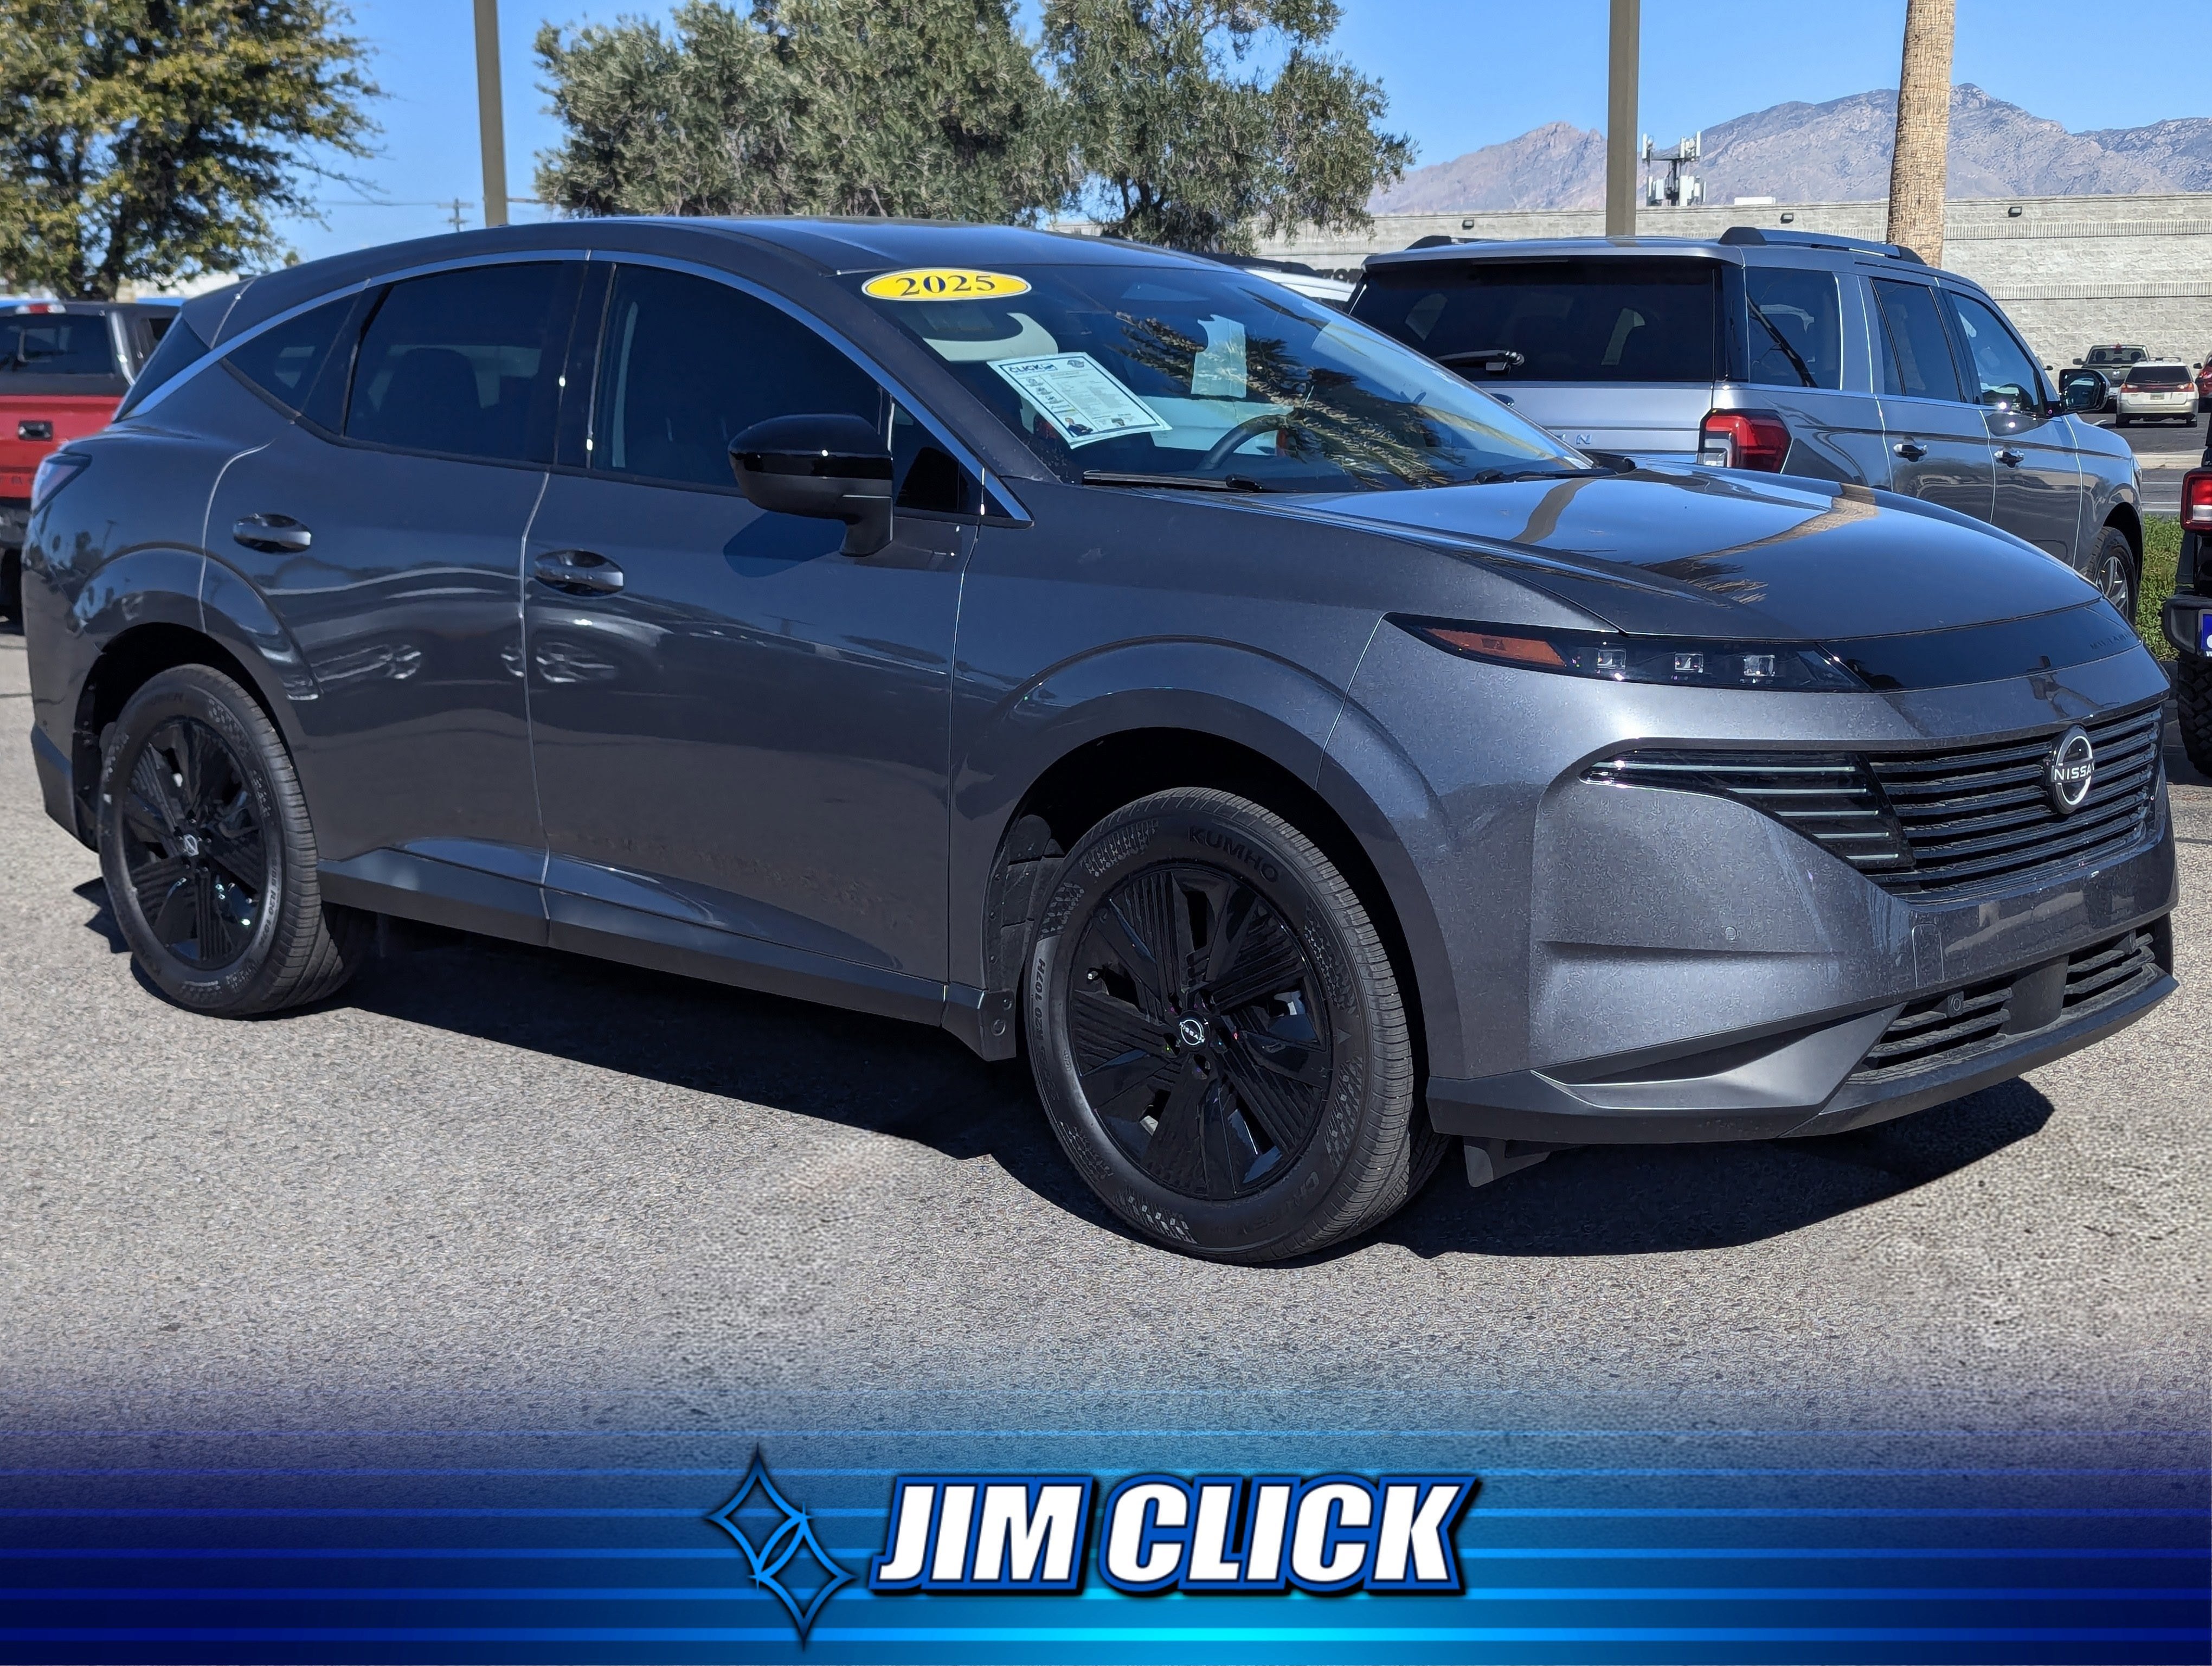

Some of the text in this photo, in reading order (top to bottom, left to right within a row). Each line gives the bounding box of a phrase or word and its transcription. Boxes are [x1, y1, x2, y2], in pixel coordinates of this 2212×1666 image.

[895, 275, 996, 296] 2025
[1186, 826, 1278, 883] KUMHO
[1034, 958, 1045, 1001] 107H
[1034, 1007, 1044, 1041] R20
